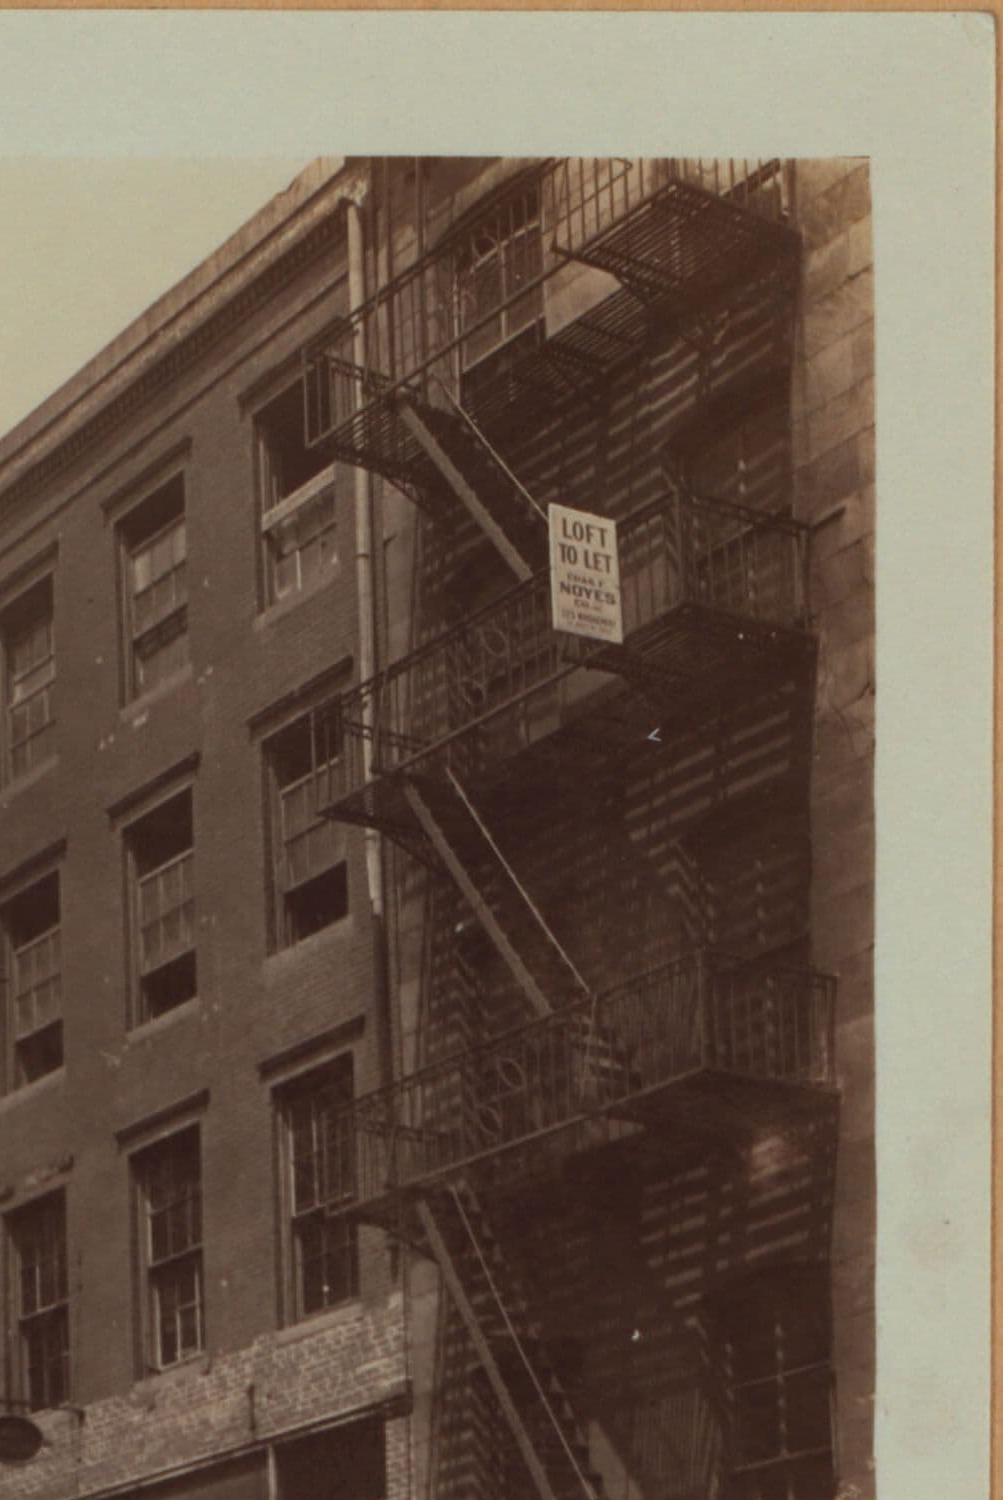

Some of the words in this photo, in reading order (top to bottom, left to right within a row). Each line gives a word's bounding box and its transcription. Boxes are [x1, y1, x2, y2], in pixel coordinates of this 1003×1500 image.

[561, 518, 608, 549] LOFT
[558, 542, 578, 565] TO
[584, 549, 613, 575] LET
[559, 581, 617, 606] NOYES
